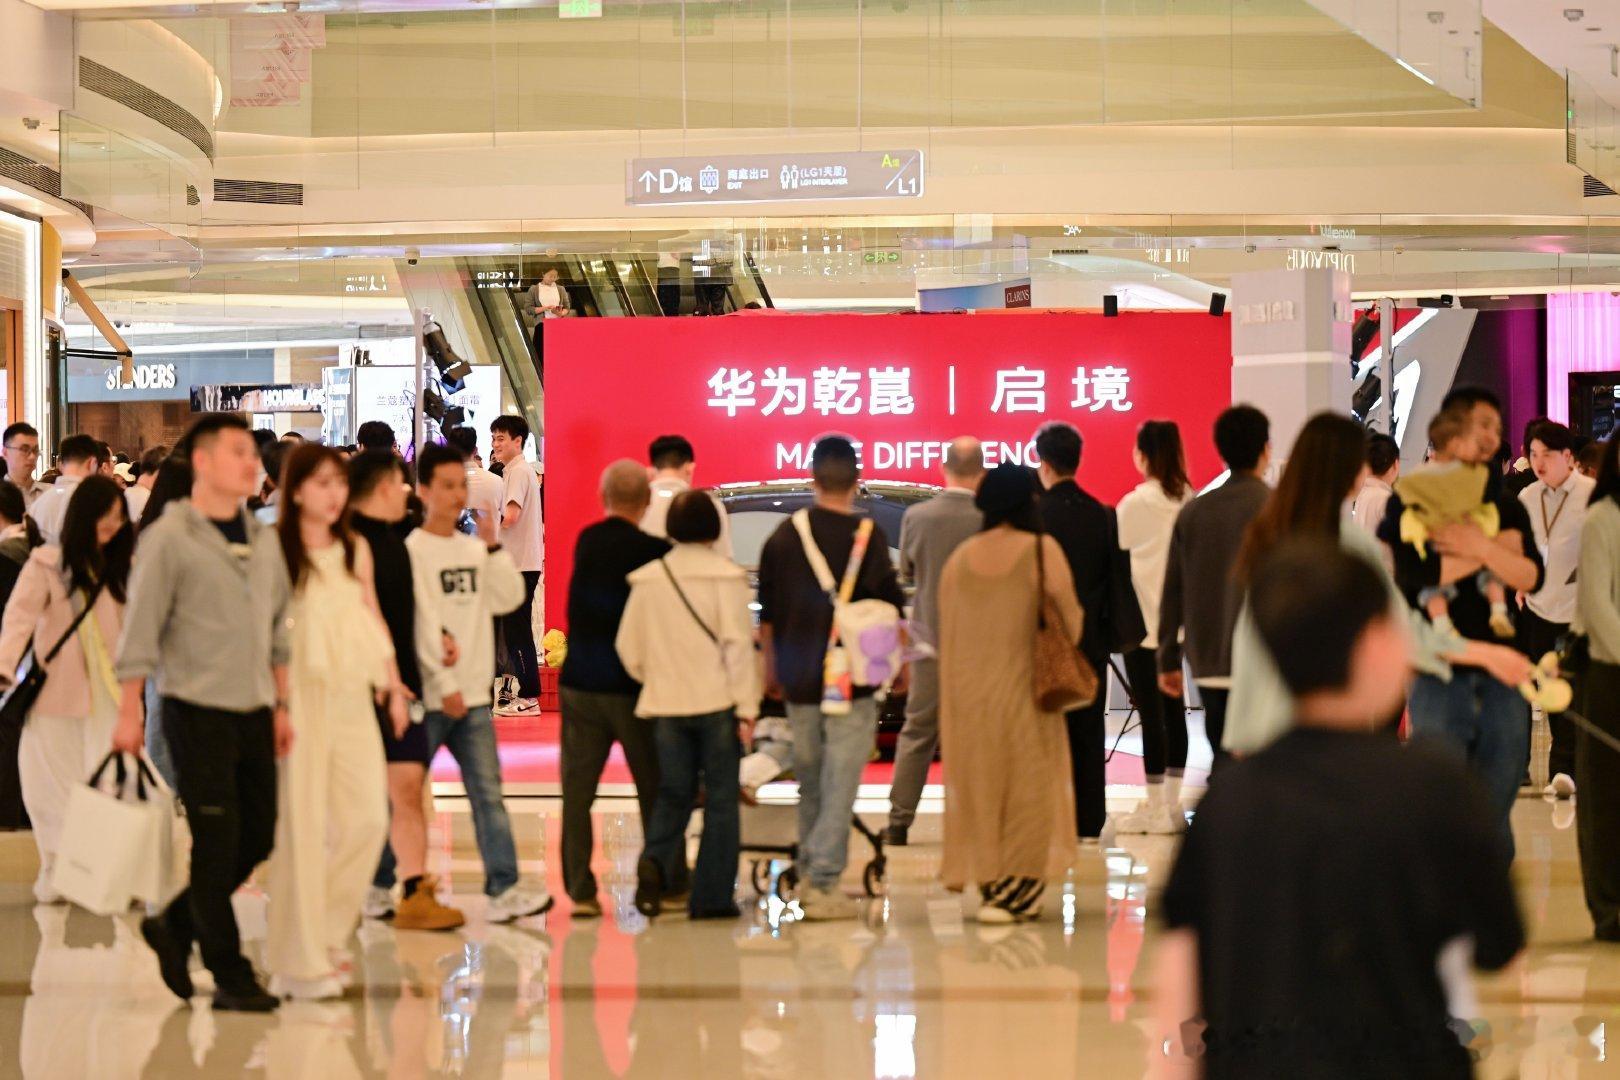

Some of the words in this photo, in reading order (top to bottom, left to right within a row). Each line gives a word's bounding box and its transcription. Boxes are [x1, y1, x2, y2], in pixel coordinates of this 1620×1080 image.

[898, 177, 916, 194] L1
[1006, 288, 1030, 303] CLARINS
[105, 363, 176, 390] STNDERS
[707, 366, 915, 417] 华为乾崑
[776, 442, 864, 470] MAE
